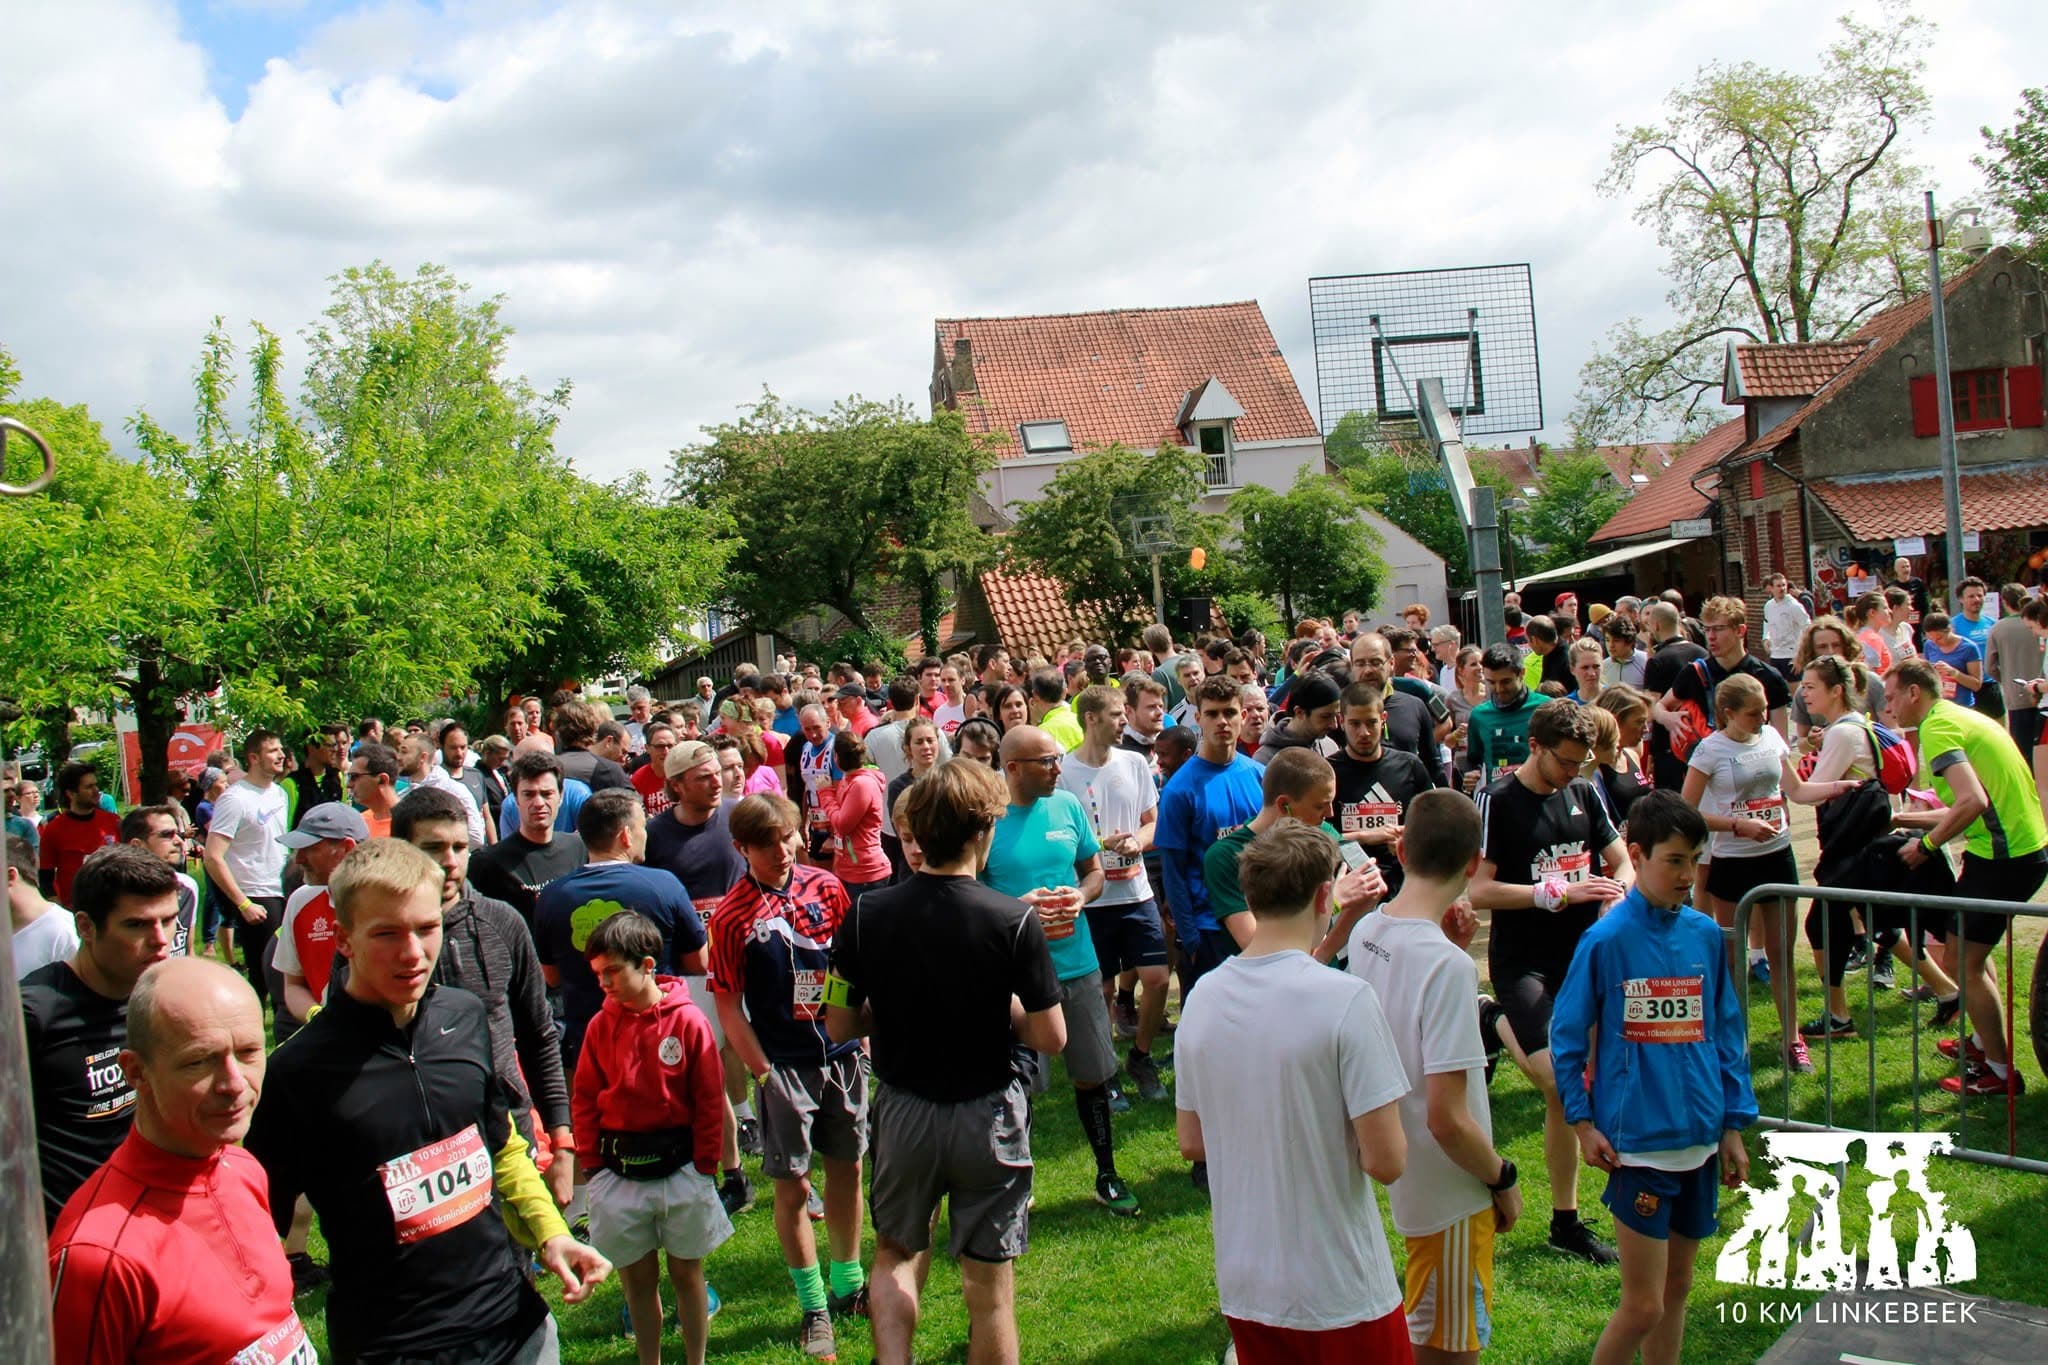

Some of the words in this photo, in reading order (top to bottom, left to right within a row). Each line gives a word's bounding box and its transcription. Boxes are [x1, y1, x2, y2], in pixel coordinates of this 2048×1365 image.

[1746, 809, 1772, 820] 159
[1356, 816, 1385, 829] 188
[1672, 988, 1688, 996] 2019
[1629, 1004, 1643, 1014] iris
[1646, 998, 1688, 1019] 303
[94, 1046, 120, 1062] BELGIUM
[416, 1150, 429, 1162] 10
[430, 1145, 445, 1157] KM
[447, 1148, 468, 1162] 2019
[474, 1159, 489, 1174] iris
[418, 1160, 473, 1204] 104
[396, 1193, 417, 1209] iris
[266, 1334, 278, 1348] 10
